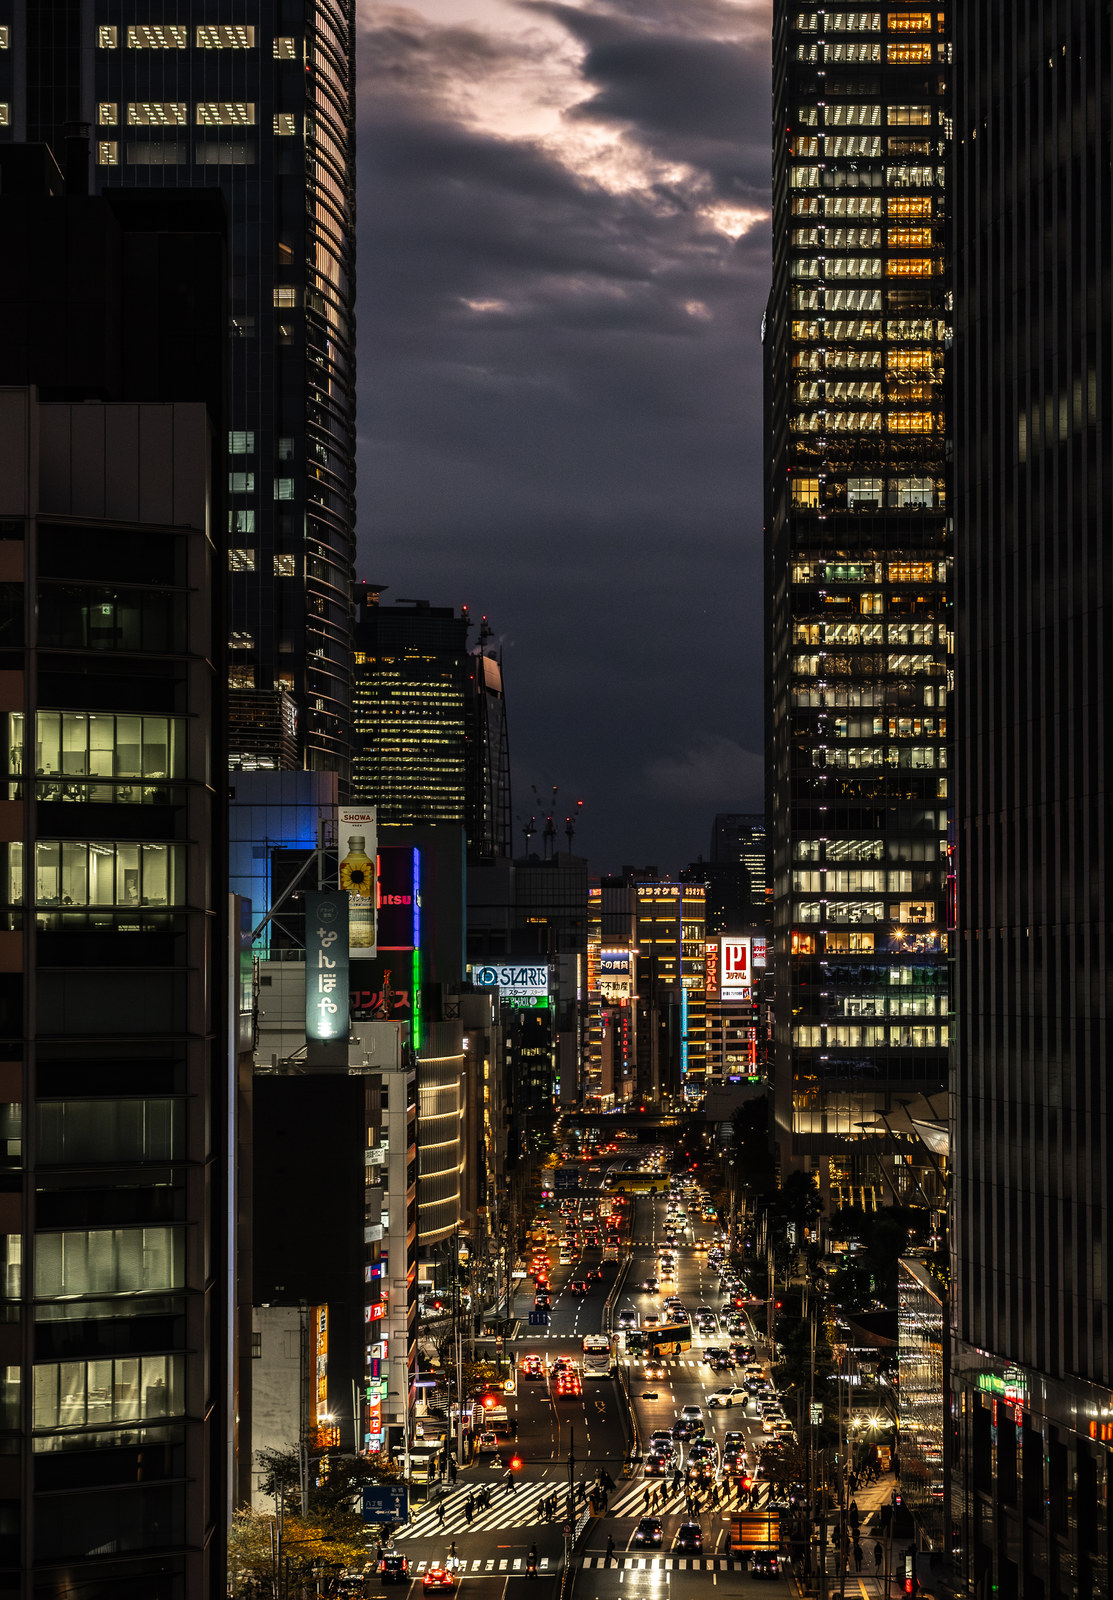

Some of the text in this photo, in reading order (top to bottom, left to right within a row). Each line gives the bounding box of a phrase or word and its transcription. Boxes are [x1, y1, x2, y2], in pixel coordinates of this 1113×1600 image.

[380, 894, 412, 906] itsu
[316, 927, 338, 1017] なんぼや
[500, 968, 547, 985] STARTS
[706, 953, 719, 992] プリマハム
[725, 972, 747, 980] プリマハム
